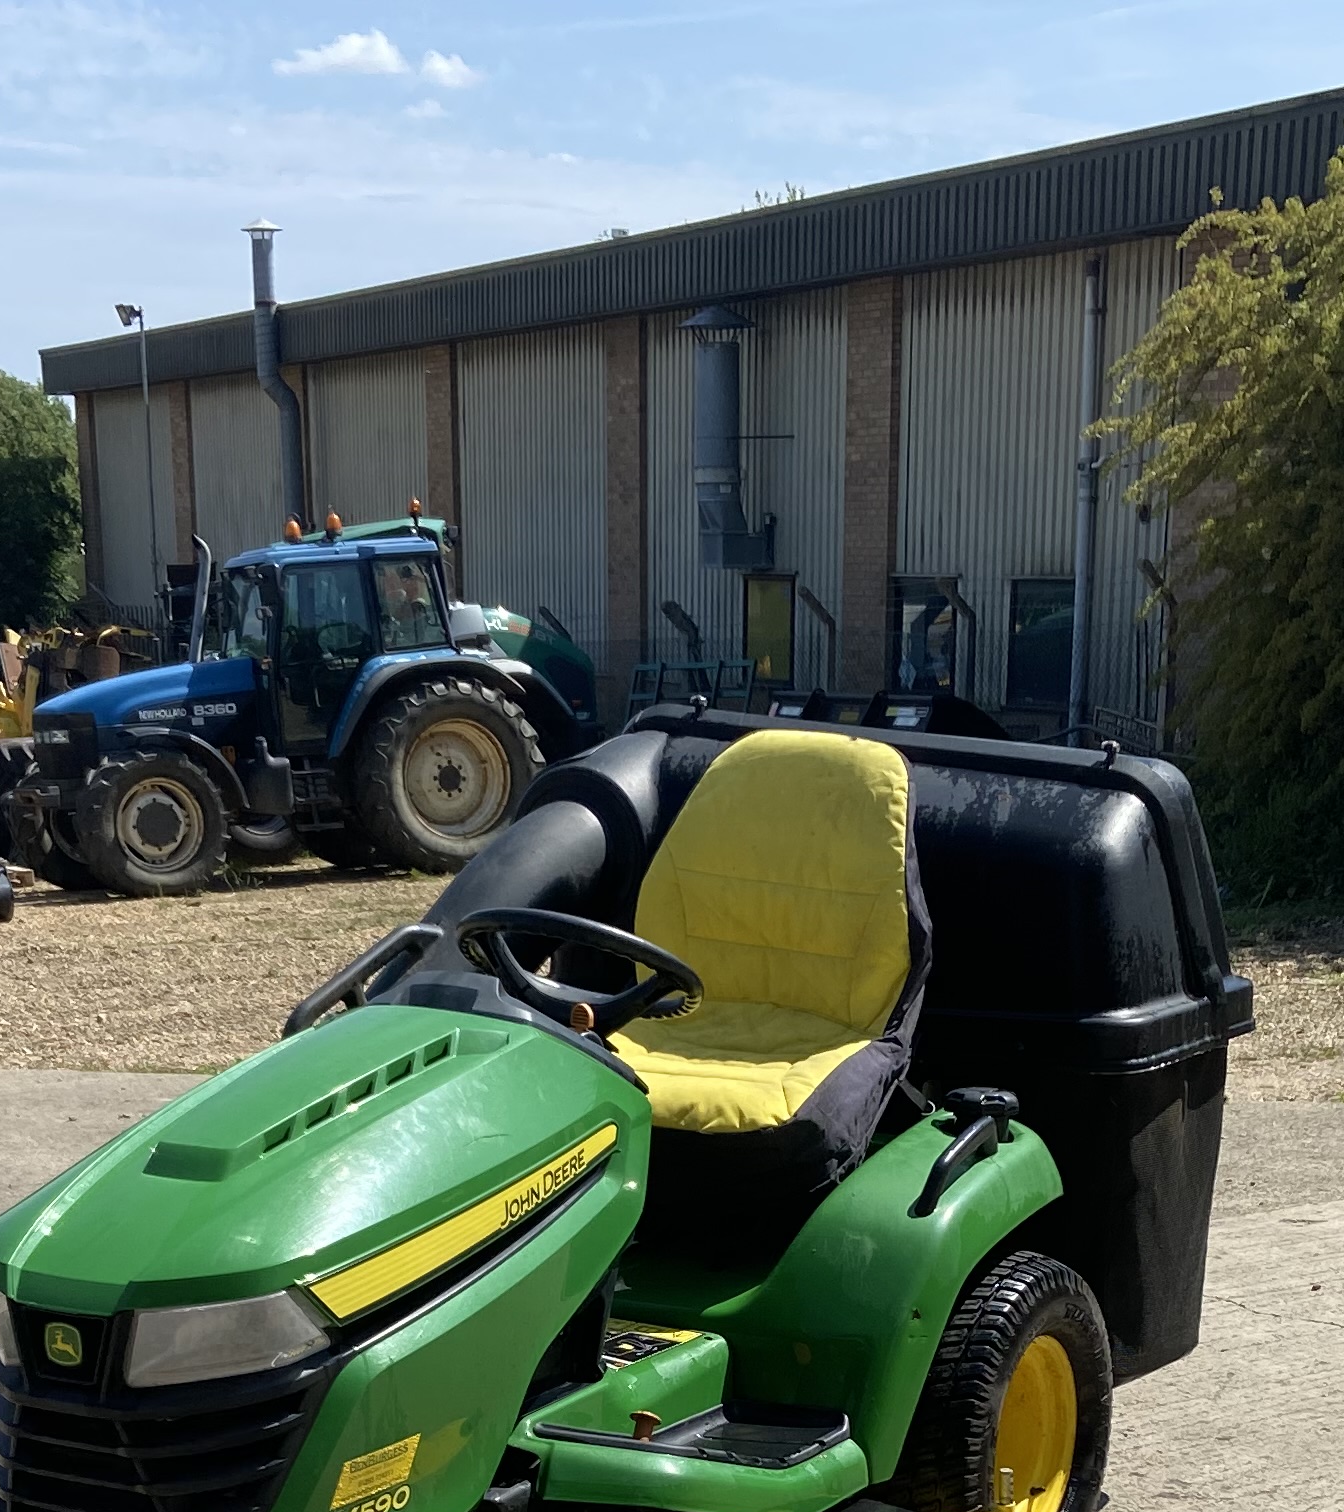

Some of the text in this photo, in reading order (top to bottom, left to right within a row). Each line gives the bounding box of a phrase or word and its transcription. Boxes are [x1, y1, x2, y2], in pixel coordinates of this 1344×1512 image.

[193, 702, 237, 716] 8360
[500, 1148, 587, 1228] JOHN DEERE
